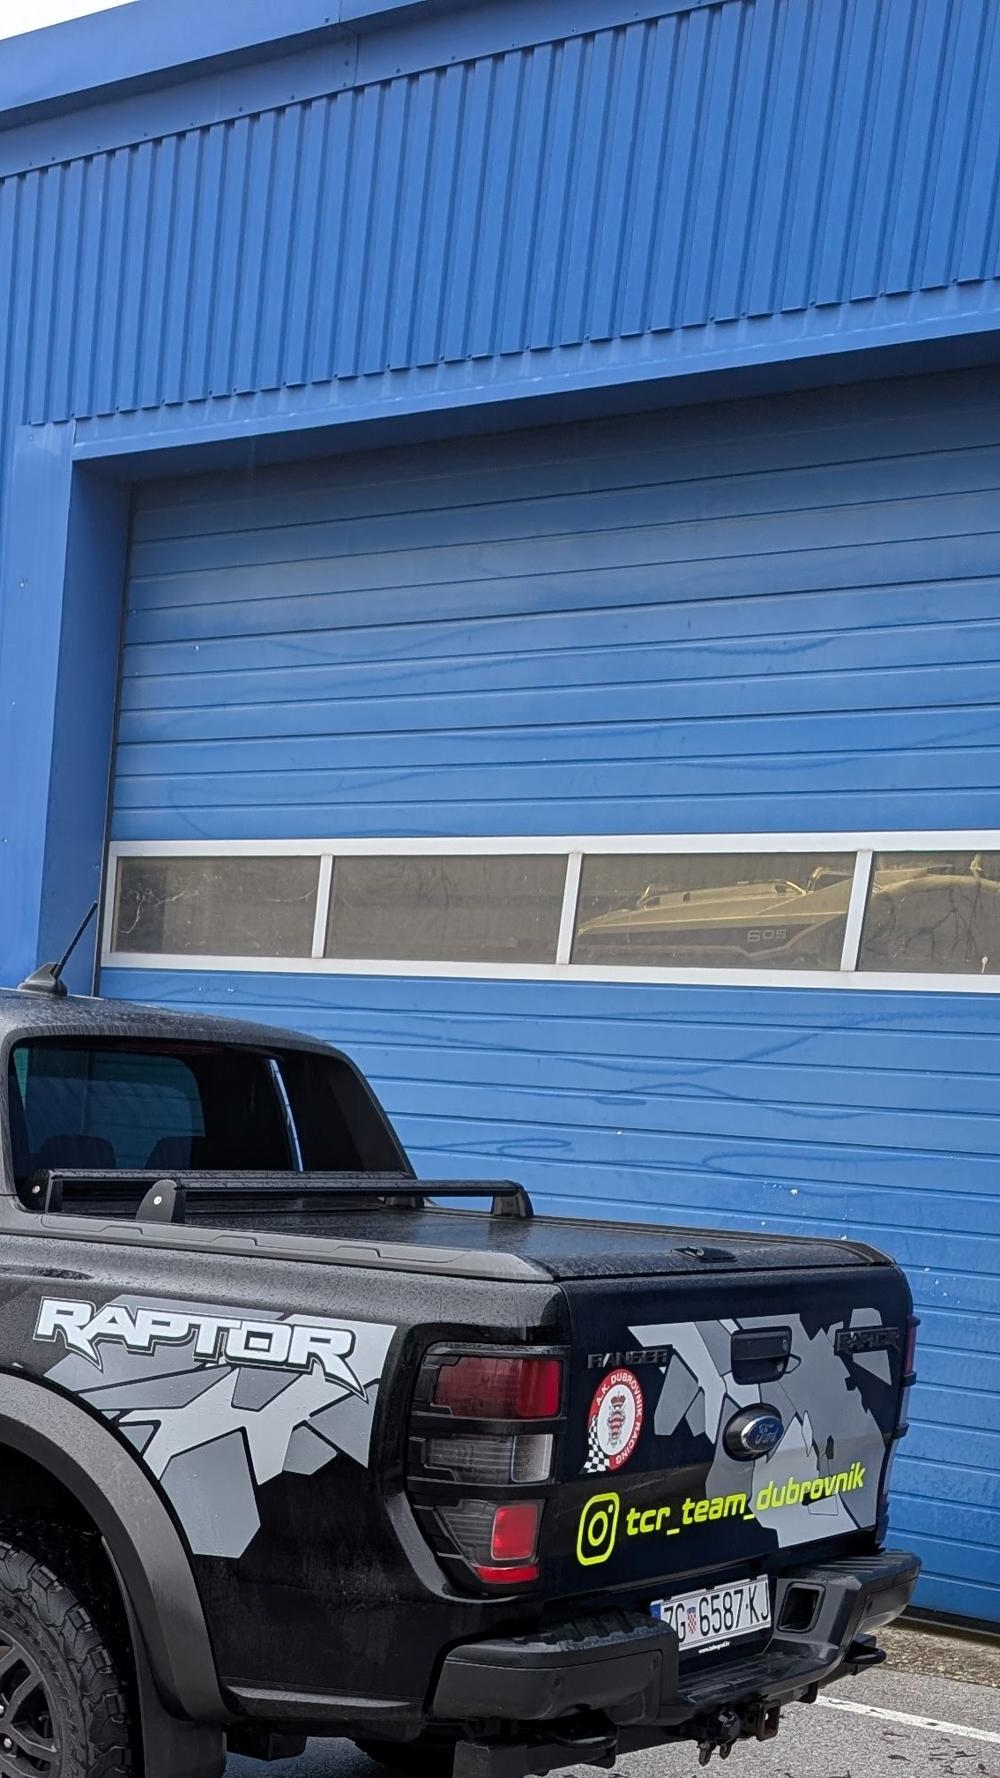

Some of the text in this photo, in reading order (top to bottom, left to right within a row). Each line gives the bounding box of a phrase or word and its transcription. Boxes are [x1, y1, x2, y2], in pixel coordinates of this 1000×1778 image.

[34, 1297, 368, 1400] RAPTOR
[596, 1373, 643, 1464] A.K. DUBROVNIK RACING
[753, 1422, 778, 1445] Ford
[626, 1462, 867, 1536] tcr_team_dubrovnik
